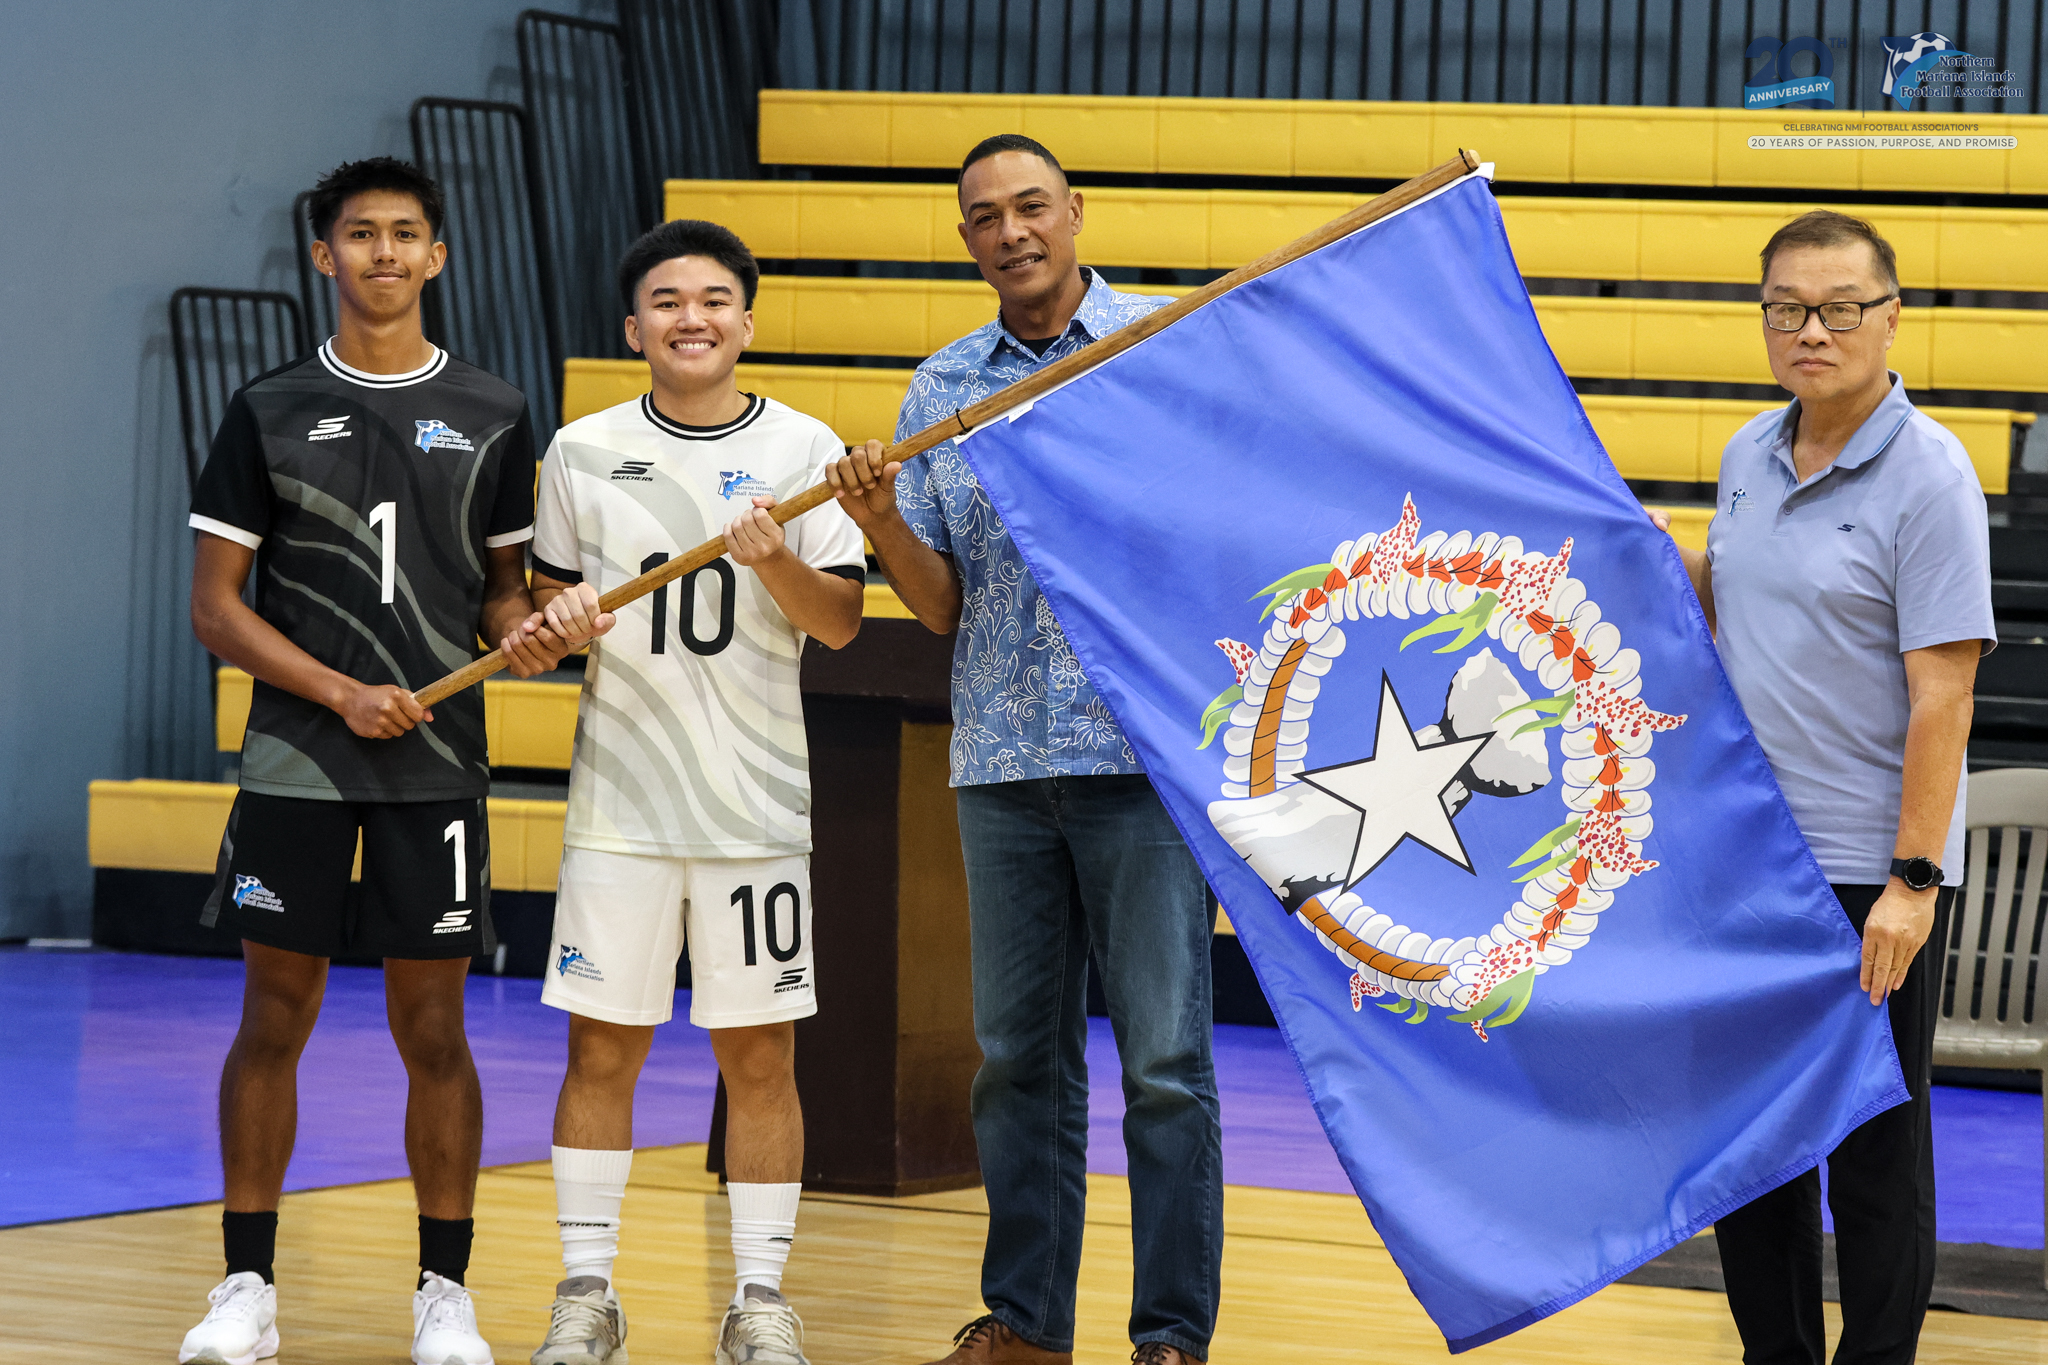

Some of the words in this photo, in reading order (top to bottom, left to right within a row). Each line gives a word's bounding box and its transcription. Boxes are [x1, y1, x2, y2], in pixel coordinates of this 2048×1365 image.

[307, 430, 353, 442] SKECHERS
[369, 501, 397, 604] 1
[640, 552, 736, 656] 10
[443, 819, 467, 902] 1
[432, 924, 473, 935] SKECHERS
[730, 881, 802, 967] 10
[773, 983, 810, 994] SKECHERS
